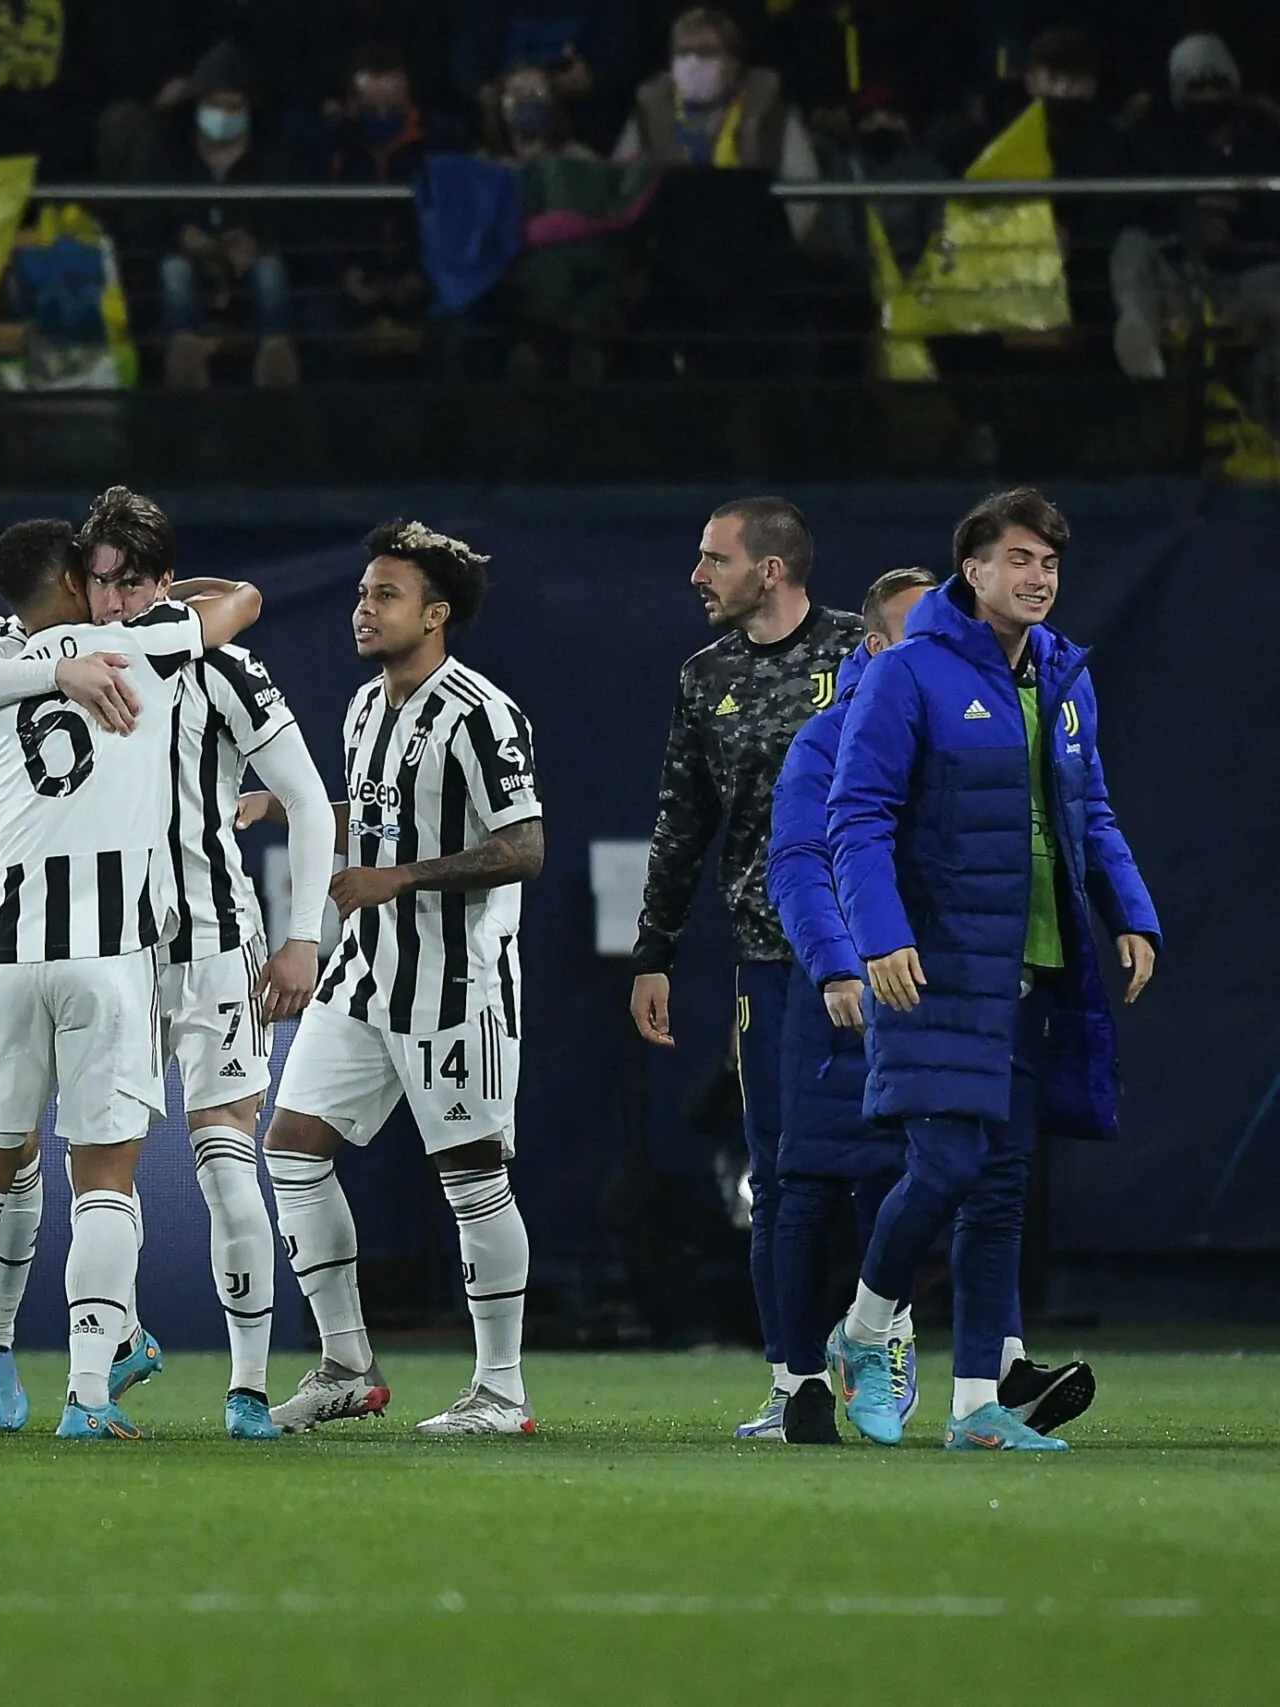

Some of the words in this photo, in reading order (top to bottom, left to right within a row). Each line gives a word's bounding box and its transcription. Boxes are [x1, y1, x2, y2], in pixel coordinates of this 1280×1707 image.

[254, 686, 282, 708] Bitg
[17, 690, 95, 798] 6
[349, 772, 400, 813] Jeep
[218, 1001, 245, 1051] 7
[219, 1070, 246, 1078] adidas
[417, 1040, 469, 1090] 14
[443, 1113, 471, 1121] adidas
[71, 1324, 105, 1336] didas
